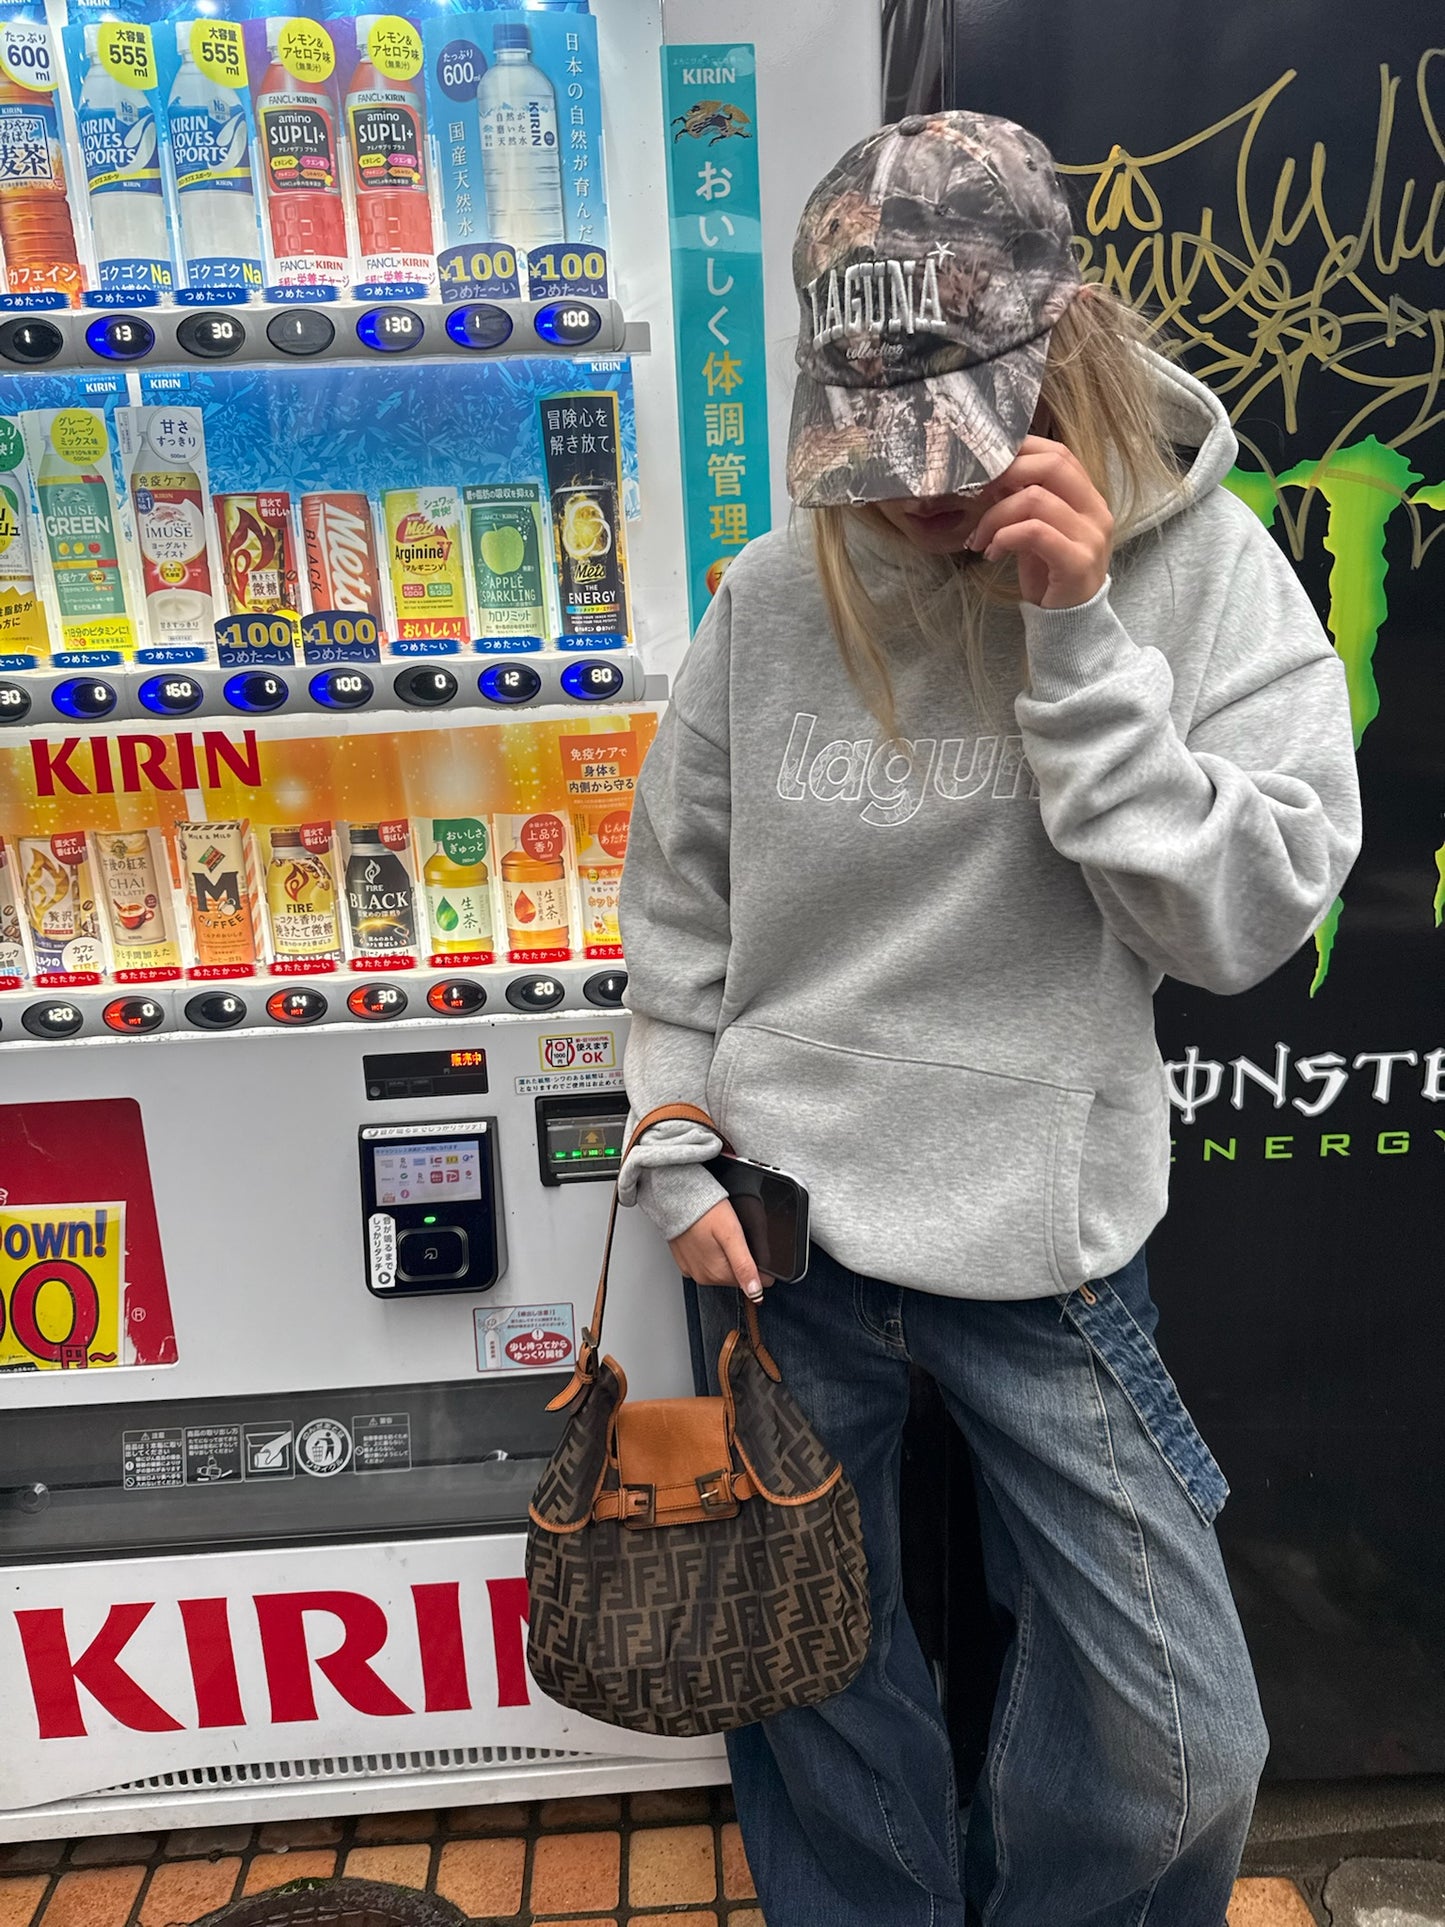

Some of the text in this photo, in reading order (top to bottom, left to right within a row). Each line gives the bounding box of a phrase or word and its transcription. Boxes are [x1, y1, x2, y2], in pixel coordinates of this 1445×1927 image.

[5, 31, 47, 45] たっぷり
[116, 29, 147, 44] 大容量
[208, 27, 238, 42] 大容量
[7, 44, 50, 69] 600
[109, 44, 148, 68] 555
[201, 41, 239, 65] 555
[283, 47, 331, 63] アセロラ味
[372, 44, 420, 61] アセロラ味
[443, 49, 473, 62] たっぷり
[35, 71, 50, 81] ml
[134, 68, 148, 77] ml
[226, 66, 240, 76] ml
[443, 62, 474, 86] 600
[682, 67, 736, 85] KIRIN
[1, 107, 23, 117] KIRIN
[278, 112, 311, 124] amino
[367, 110, 400, 122] amino
[0, 119, 37, 131] わやか
[81, 118, 116, 135] KIRIN
[170, 115, 208, 134] KIRIN
[528, 101, 542, 146] KIRIN
[173, 131, 215, 148] LOVES
[270, 124, 326, 145] SUPLI+
[359, 123, 414, 144] SUPLI+
[565, 32, 594, 243] 日本の自然が育んだ
[83, 133, 122, 152] LOVES
[0, 143, 47, 177] 麦茶
[86, 148, 137, 168] SPORTS
[175, 146, 229, 165] SPORTS
[448, 121, 475, 237] 国産天然水
[100, 263, 171, 285] ゴクゴク Na
[190, 262, 262, 284] ゴクゴク Na
[439, 251, 516, 284] ¥100
[529, 252, 605, 281] ¥100
[9, 265, 77, 286] カフェイン
[807, 258, 948, 350] LAGUNA
[385, 316, 412, 332] 130
[562, 310, 590, 328] 100
[212, 322, 233, 339] 30
[695, 160, 750, 546] おいしく体調管理
[591, 361, 621, 372] KIRIN
[86, 382, 117, 393] KIRIN
[150, 379, 181, 389] KIRIN
[58, 416, 94, 426] グレープ
[160, 419, 189, 434] 甘さ
[547, 407, 608, 431] 冒険心を
[60, 427, 95, 437] フルーツ
[156, 436, 197, 447] すっきり
[550, 433, 616, 456] 解き放て。
[139, 474, 187, 487] 免疫ケア
[52, 503, 96, 516] iMUSE
[259, 498, 282, 507] 直火で
[261, 508, 290, 517] 香ばしい
[46, 515, 110, 536] GREEN
[145, 523, 193, 538] iMUSE
[156, 550, 185, 558] テイスト
[305, 529, 323, 594] BLACK
[395, 544, 444, 563] Arginine
[575, 563, 606, 579] Mets
[252, 582, 278, 595] 微糖
[489, 575, 524, 589] APPLE
[482, 588, 536, 603] SPARKLING
[568, 590, 616, 604] ENERGY
[488, 610, 532, 622] カロリミット
[216, 621, 291, 648] ¥100
[303, 619, 376, 646] ¥100
[336, 675, 362, 691] 100
[591, 667, 613, 683] 80
[166, 682, 191, 698] 160
[570, 746, 628, 761] 免疫ケアで
[29, 729, 262, 796] KIRIN
[584, 764, 617, 777] 身体を
[568, 778, 634, 793] 内側から守る
[527, 827, 560, 841] 上品な
[449, 842, 485, 854] ぎゅっと
[534, 840, 554, 853] 香り
[108, 877, 146, 890] CHAI
[192, 870, 243, 913] M
[366, 884, 384, 892] FIRE
[286, 902, 314, 914] FIRE
[349, 890, 409, 910] BLACK
[544, 889, 559, 920] 生茶
[48, 911, 74, 922] 贅沢
[279, 913, 324, 924] コクと香りの
[461, 896, 479, 930] 生茶
[275, 922, 334, 938] 挽きたて微糖
[72, 945, 95, 954] カフェ
[77, 954, 93, 962] オレ
[377, 990, 397, 1004] 30
[576, 1041, 610, 1052] 使えます
[450, 1051, 482, 1067] 販売中
[582, 1051, 604, 1064] OK
[1170, 1129, 1445, 1163] NERG
[0, 1209, 107, 1260] own!
[509, 1340, 568, 1352] 少し待ってから
[514, 1349, 565, 1360] ゆっくり開栓
